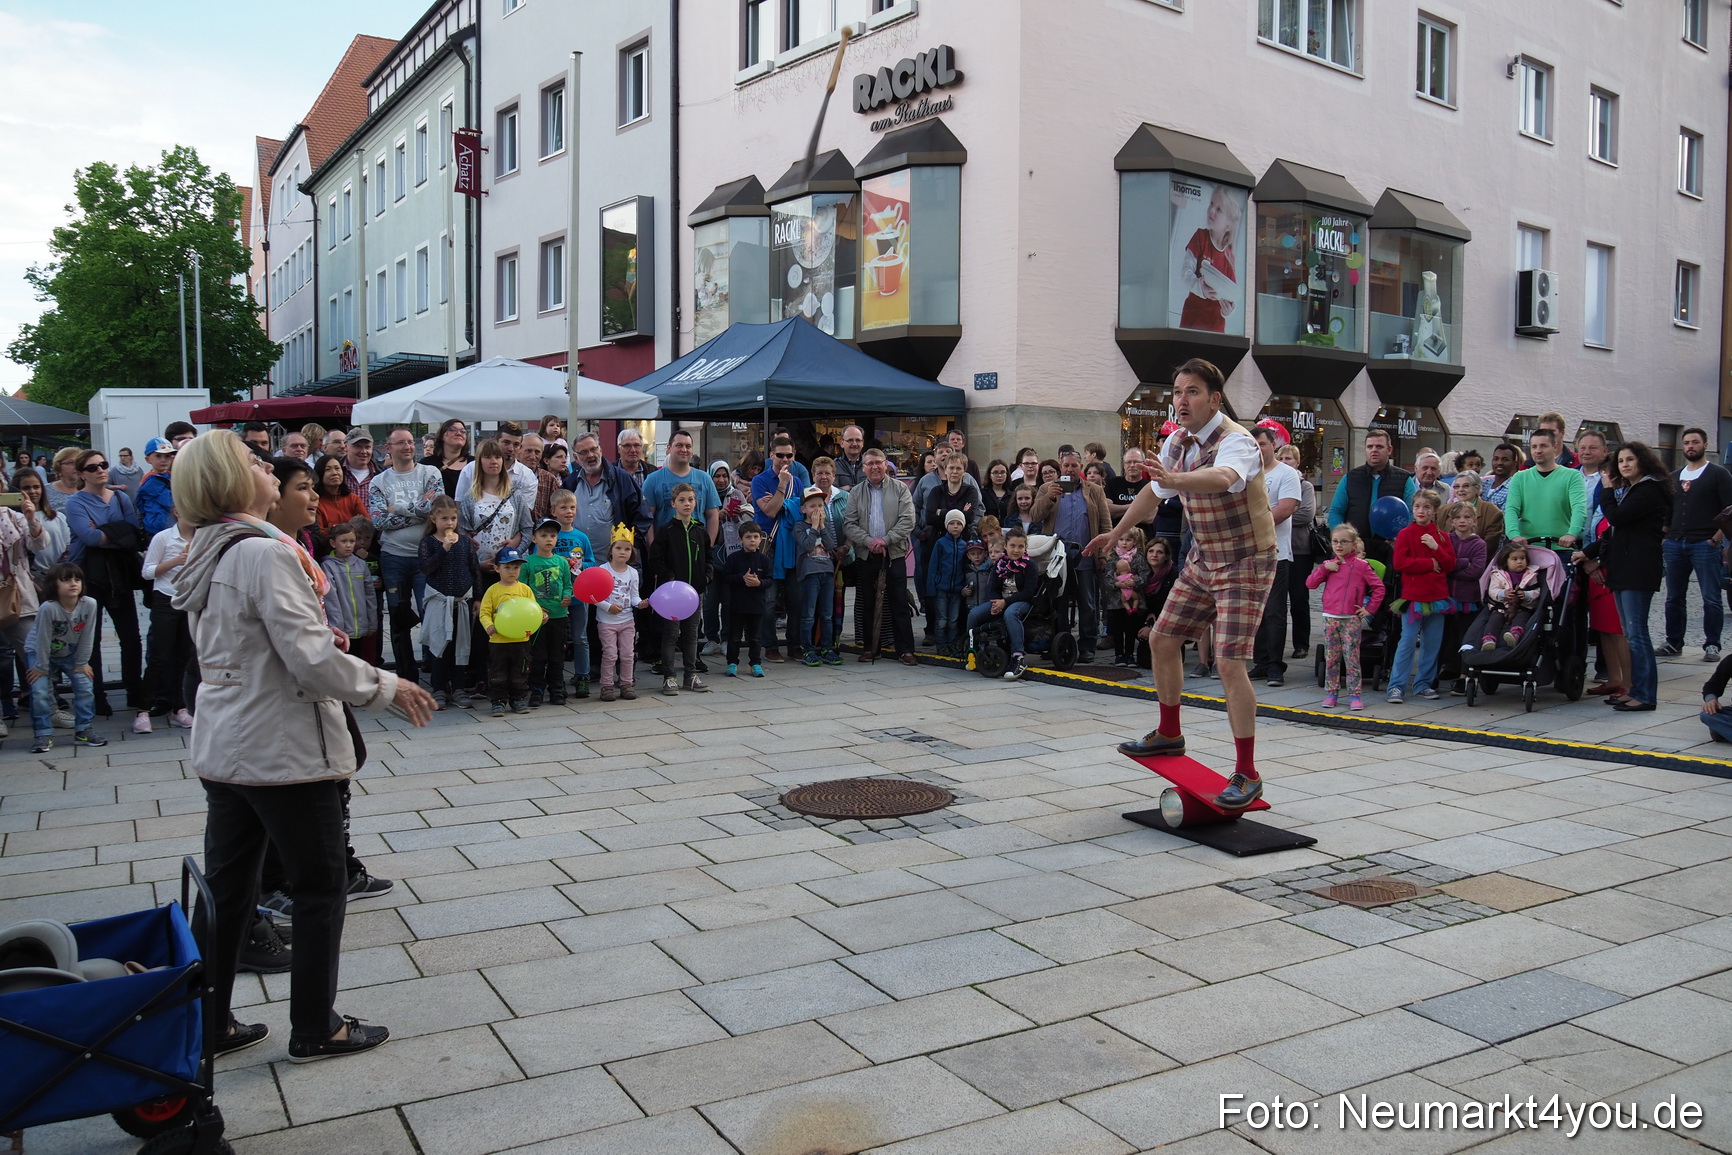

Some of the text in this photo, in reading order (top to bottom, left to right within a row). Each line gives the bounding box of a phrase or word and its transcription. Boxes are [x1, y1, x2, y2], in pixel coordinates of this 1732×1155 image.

[853, 44, 962, 114] RACKL
[870, 94, 953, 132] am Rathaus
[459, 143, 474, 190] Achatz
[1172, 181, 1201, 197] Thomas
[775, 219, 800, 245] RACKL
[1321, 217, 1349, 227] 100 Jahre
[1318, 227, 1344, 252] RACKL
[339, 347, 358, 374] RENO
[334, 405, 351, 415] Ach
[1125, 406, 1158, 416] Willkommen
[1160, 409, 1167, 417] im
[1293, 411, 1315, 430] RACKL
[1398, 419, 1417, 435] RACKL
